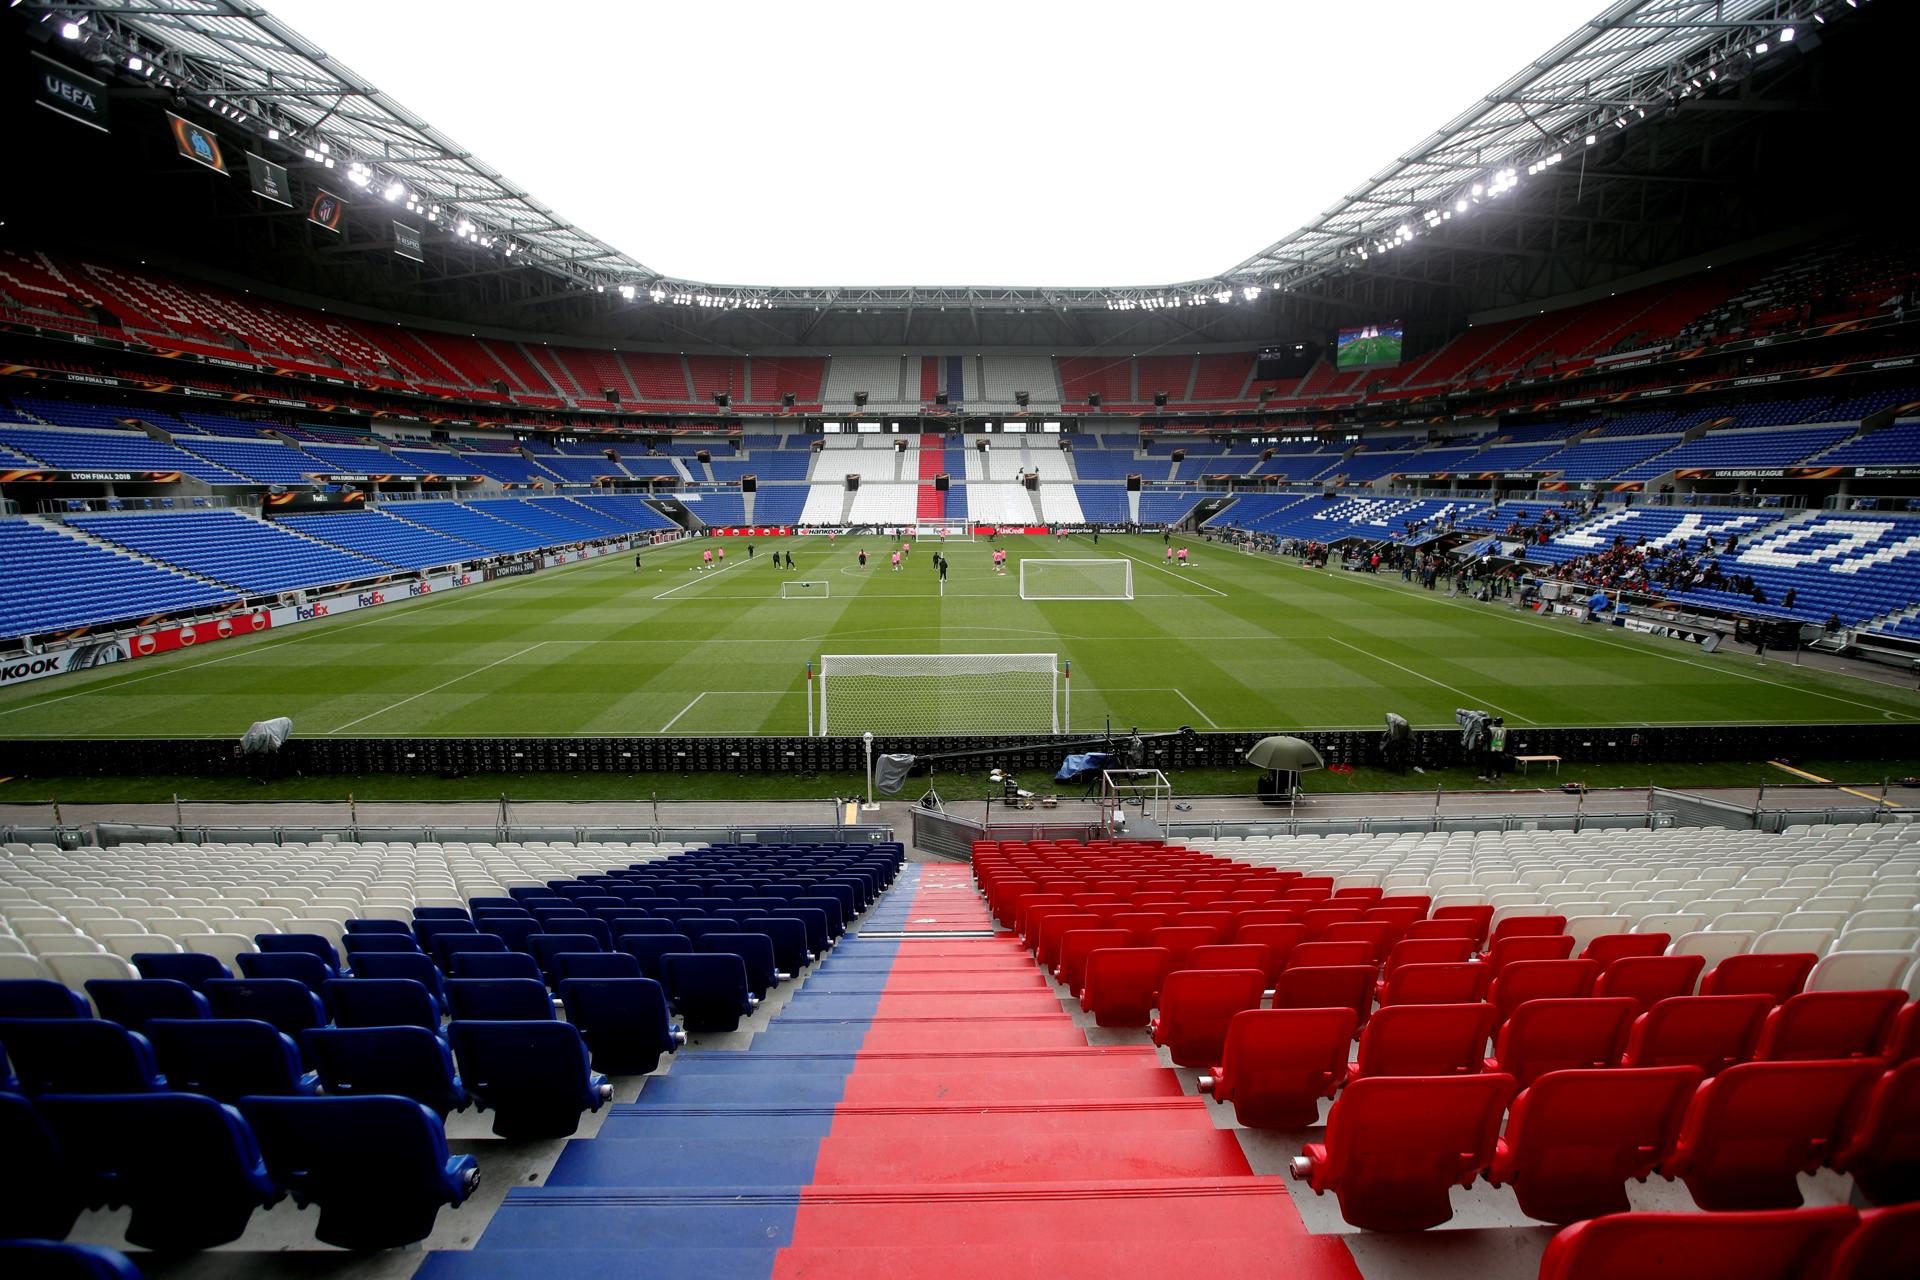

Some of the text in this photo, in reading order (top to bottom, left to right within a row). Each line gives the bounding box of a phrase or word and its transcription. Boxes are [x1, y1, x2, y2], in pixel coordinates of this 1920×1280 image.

[46, 75, 96, 110] UEFA
[1000, 527, 1025, 535] UniCredit
[497, 566, 510, 577] LYON
[510, 564, 523, 573] FINAL
[452, 574, 471, 587] FedEx
[409, 582, 432, 596] FedEx
[358, 591, 384, 607] FedEx
[296, 602, 328, 620] FedEx
[0, 656, 60, 681] KOOK
